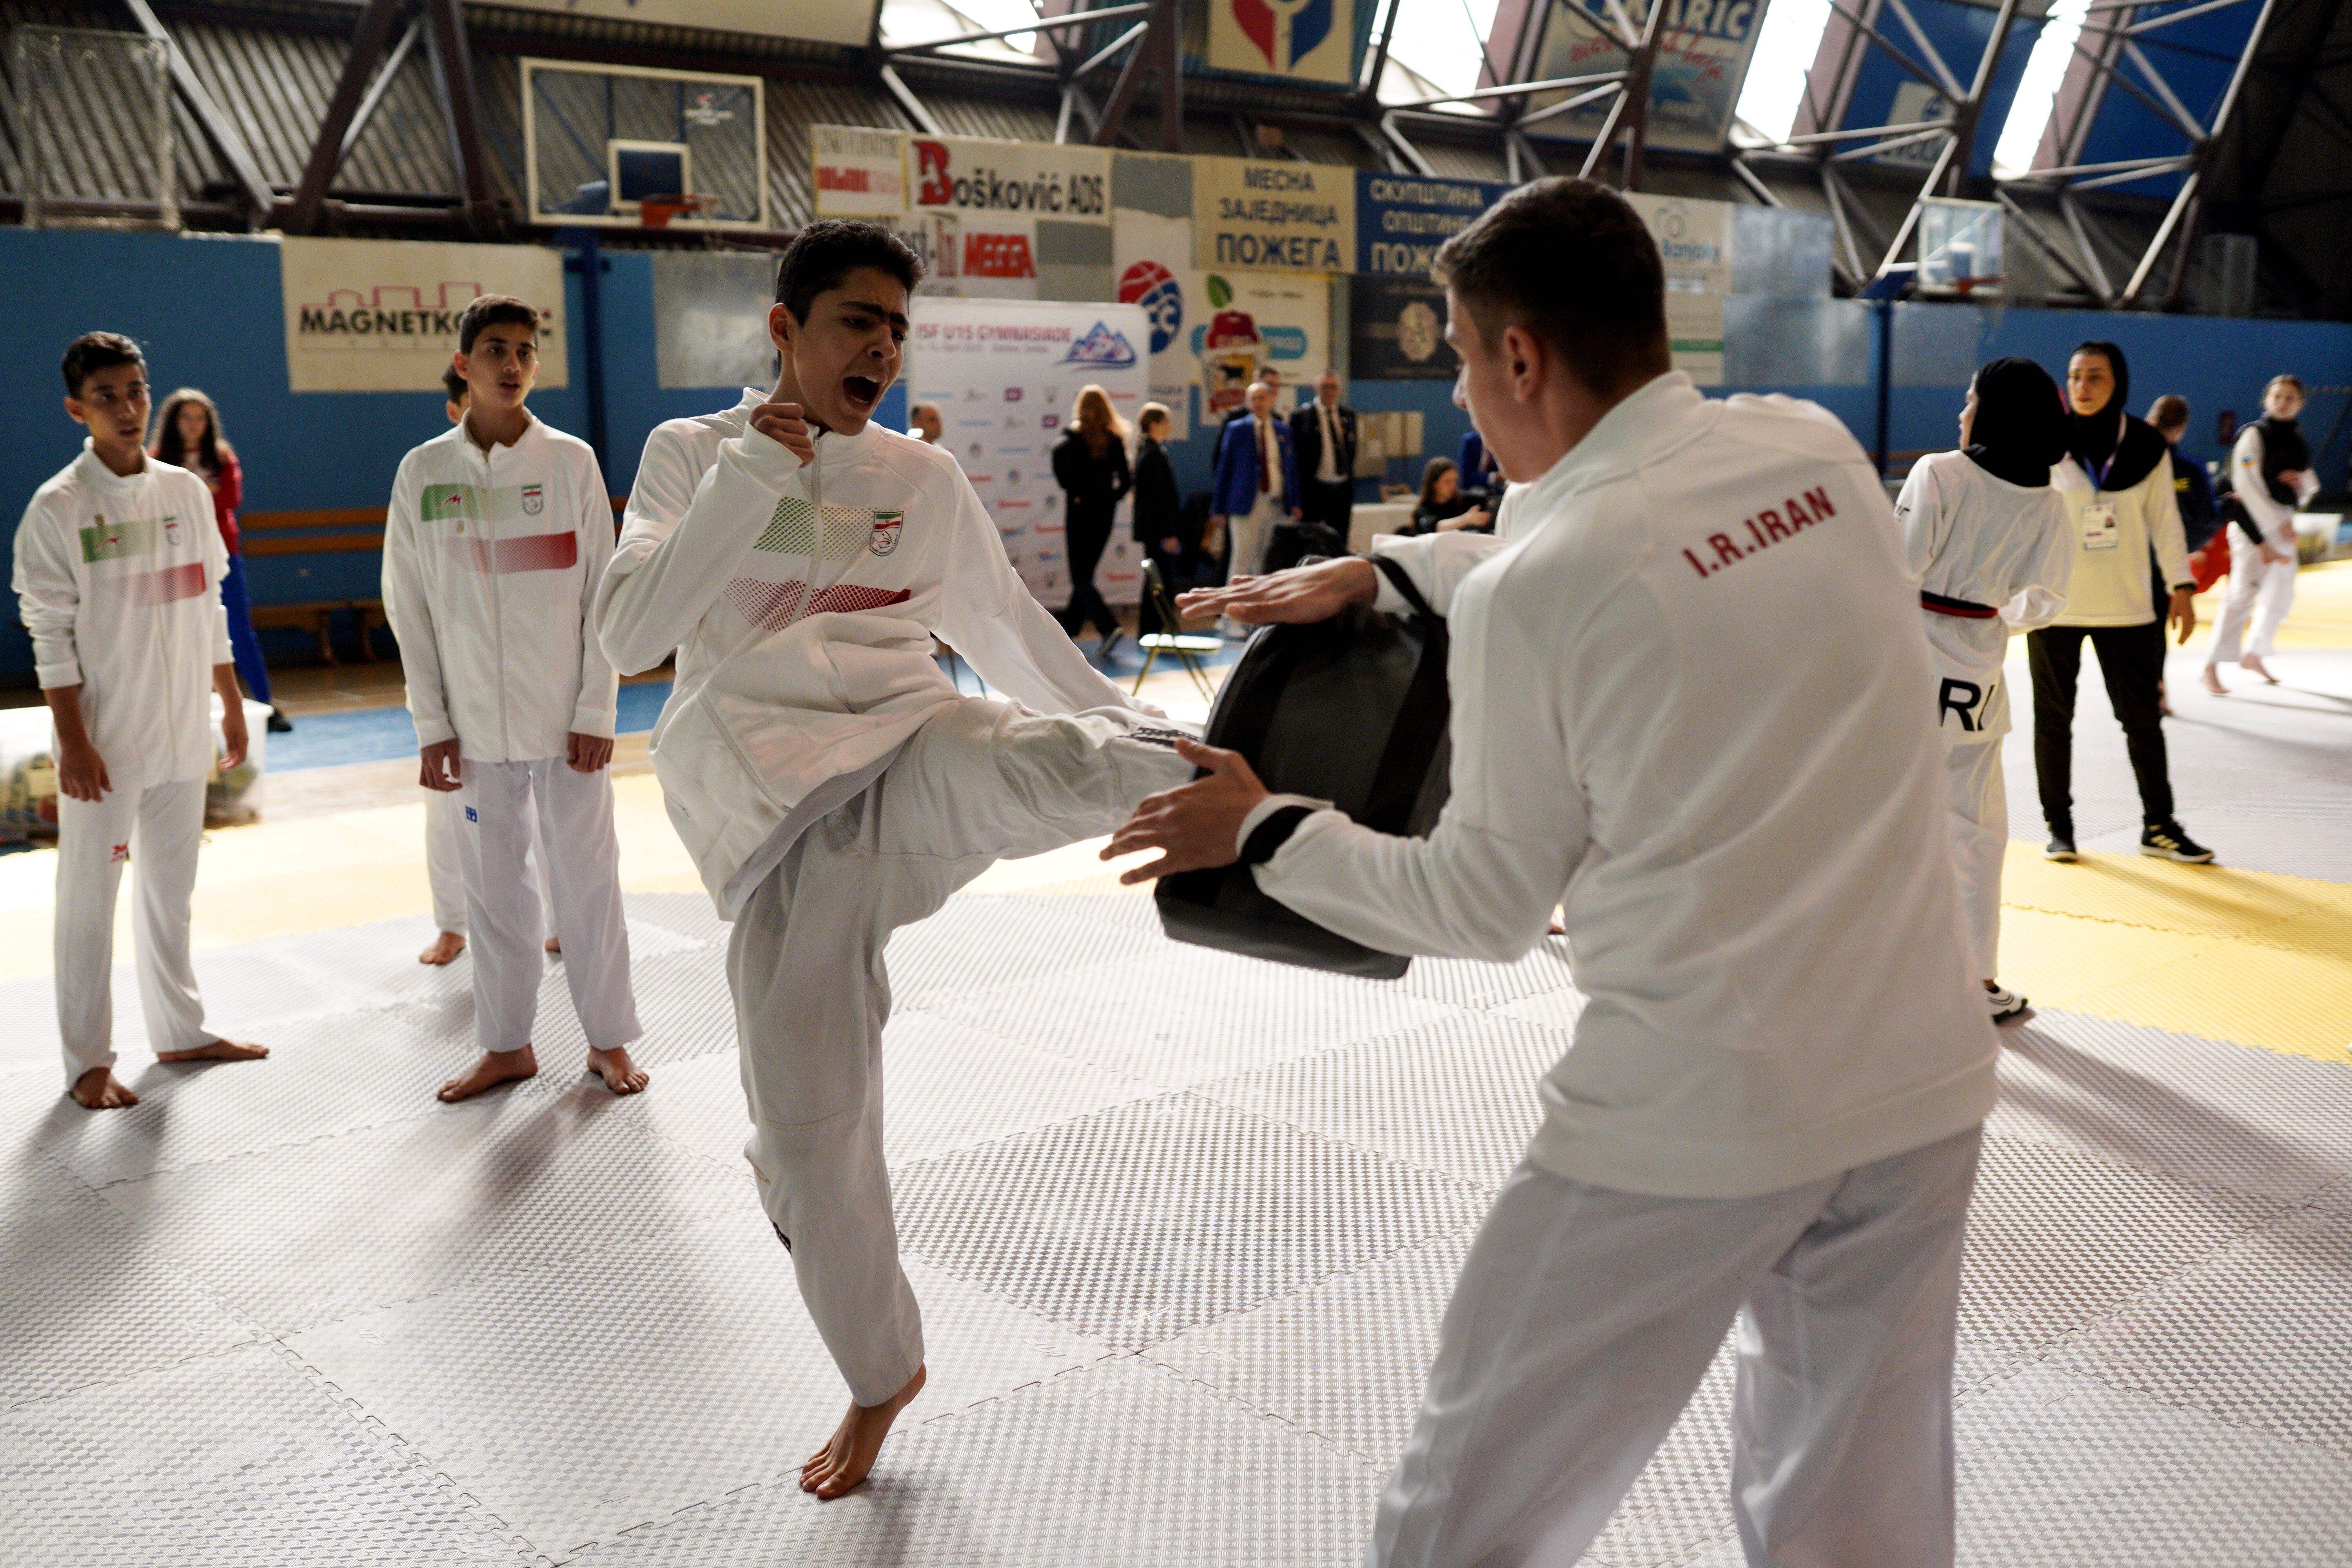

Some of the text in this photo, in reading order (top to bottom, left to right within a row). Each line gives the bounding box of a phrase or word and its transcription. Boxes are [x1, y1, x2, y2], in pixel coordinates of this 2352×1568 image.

[912, 140, 1062, 211] Bošković
[1244, 167, 1315, 191] МЕСНА
[1370, 178, 1484, 207] СКУПШТИНА
[1219, 197, 1339, 230] ЗАЈЕДНИЦА
[1217, 232, 1341, 268] ПОЖЕГА
[1372, 241, 1444, 272] ПОЖ
[1682, 485, 1837, 578] I.R.IRAN
